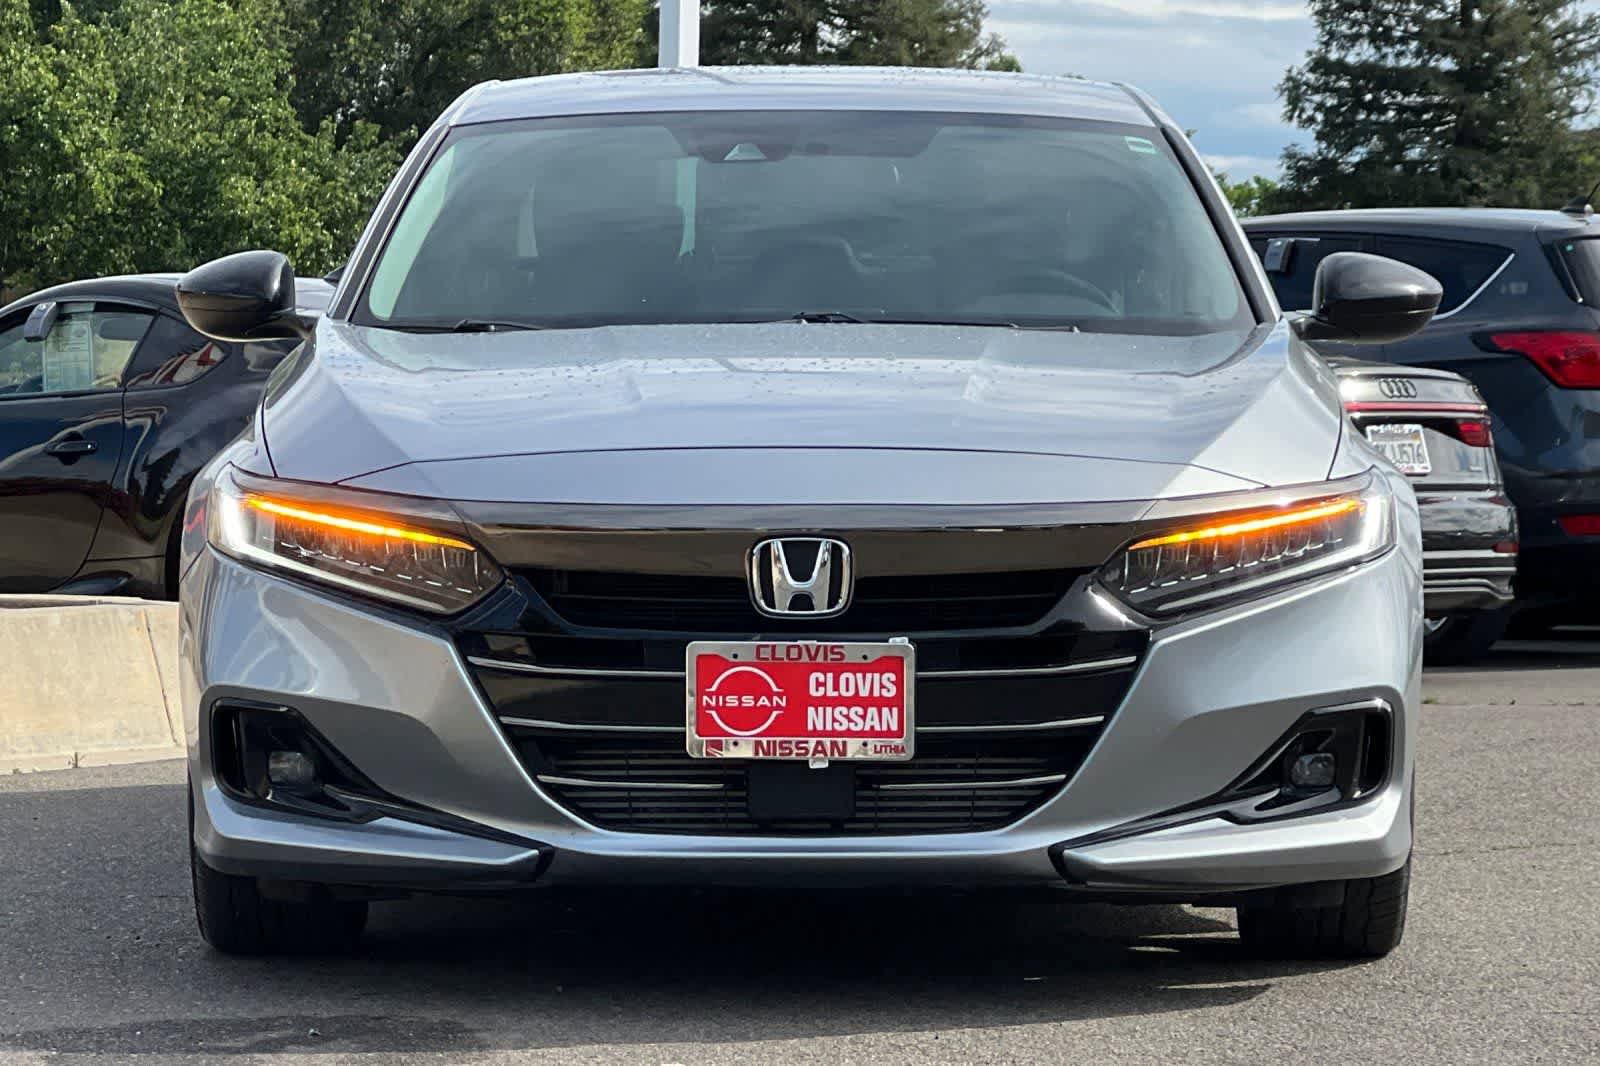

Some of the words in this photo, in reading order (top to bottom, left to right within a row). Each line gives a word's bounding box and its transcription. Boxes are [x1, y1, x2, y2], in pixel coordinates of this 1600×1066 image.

[755, 644, 846, 662] CLOVIS
[808, 672, 897, 698] CLOVIS
[702, 695, 787, 707] NISSAN
[807, 706, 898, 731] NISSAN
[754, 740, 847, 757] NISSAN
[874, 744, 906, 754] LITHIA
